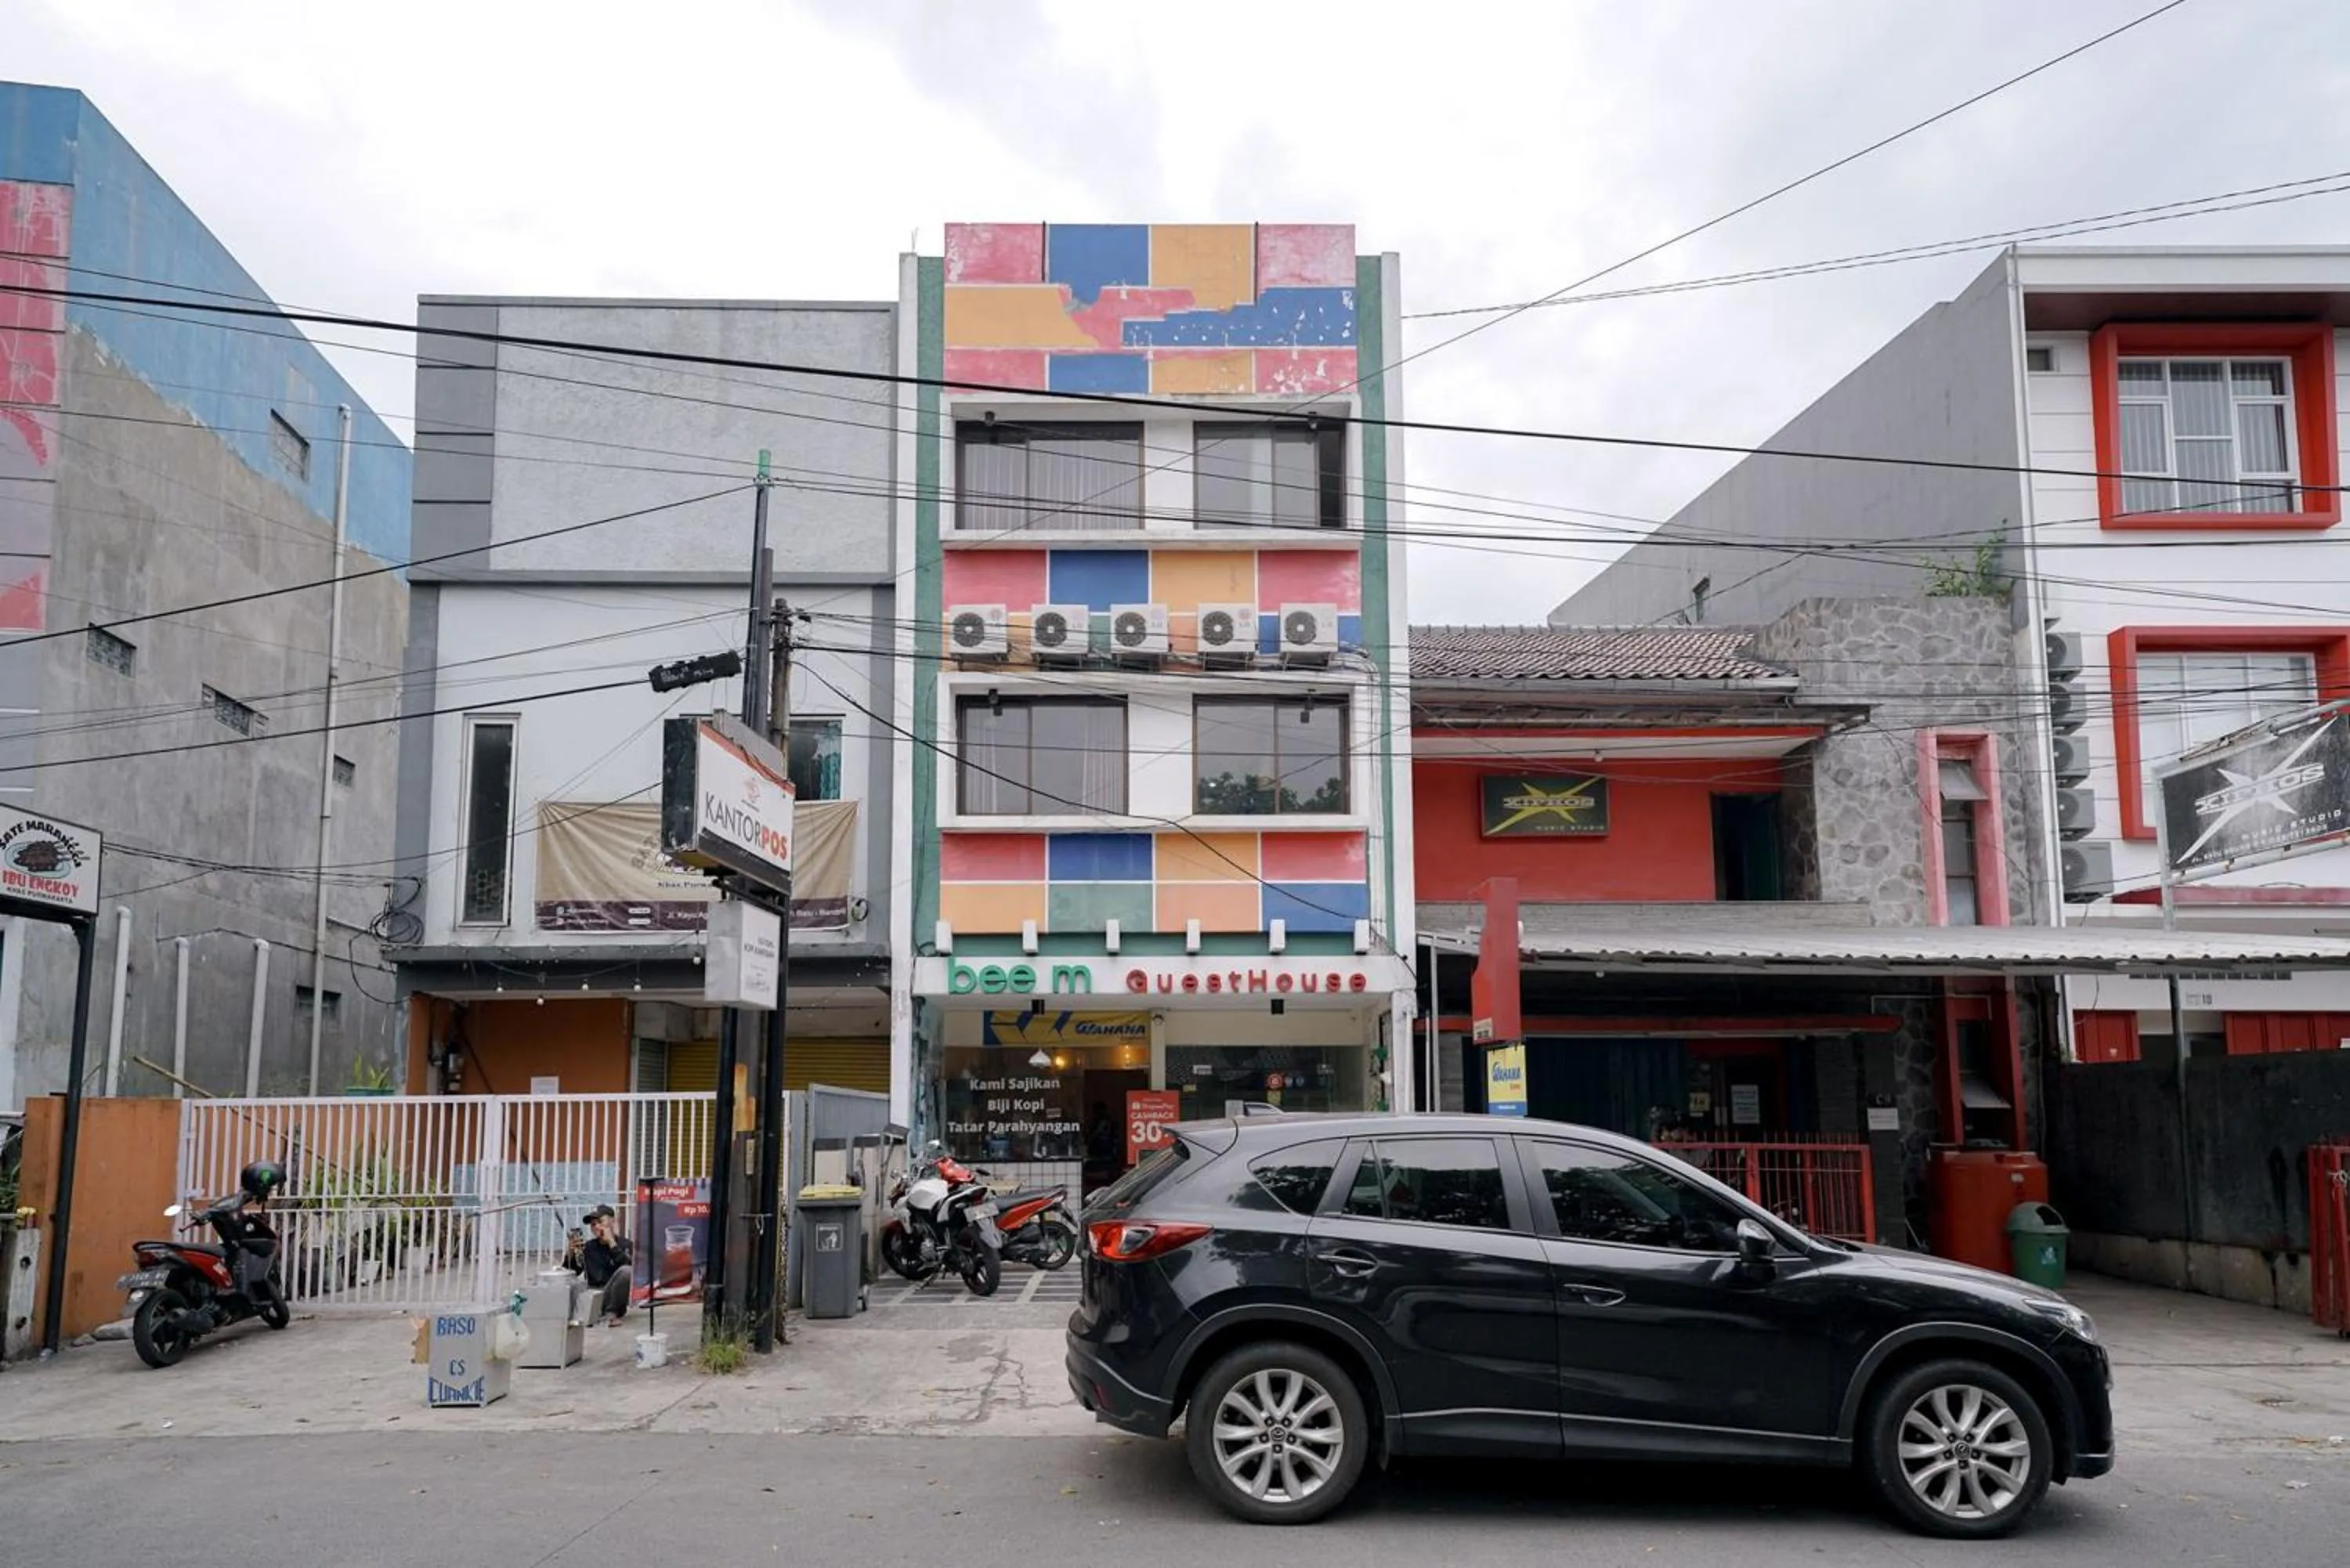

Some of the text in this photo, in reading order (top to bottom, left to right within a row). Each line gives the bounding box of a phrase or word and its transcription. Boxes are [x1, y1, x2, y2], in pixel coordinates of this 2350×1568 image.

[2290, 808, 2342, 829] STUDIO
[2, 870, 26, 887] IBU
[948, 957, 1036, 995] bee
[1052, 964, 1092, 994] m
[970, 1077, 1061, 1093] Kami Sajikan
[987, 1098, 1044, 1114] Biji Kopi
[1130, 1111, 1174, 1120] CASHBACK
[947, 1119, 1080, 1134] Tatar Parahyangan
[1130, 1121, 1170, 1143] 30
[668, 1186, 689, 1200] Pagi
[684, 1205, 696, 1216] Rp
[437, 1317, 475, 1336] BASO
[450, 1359, 465, 1376] CS
